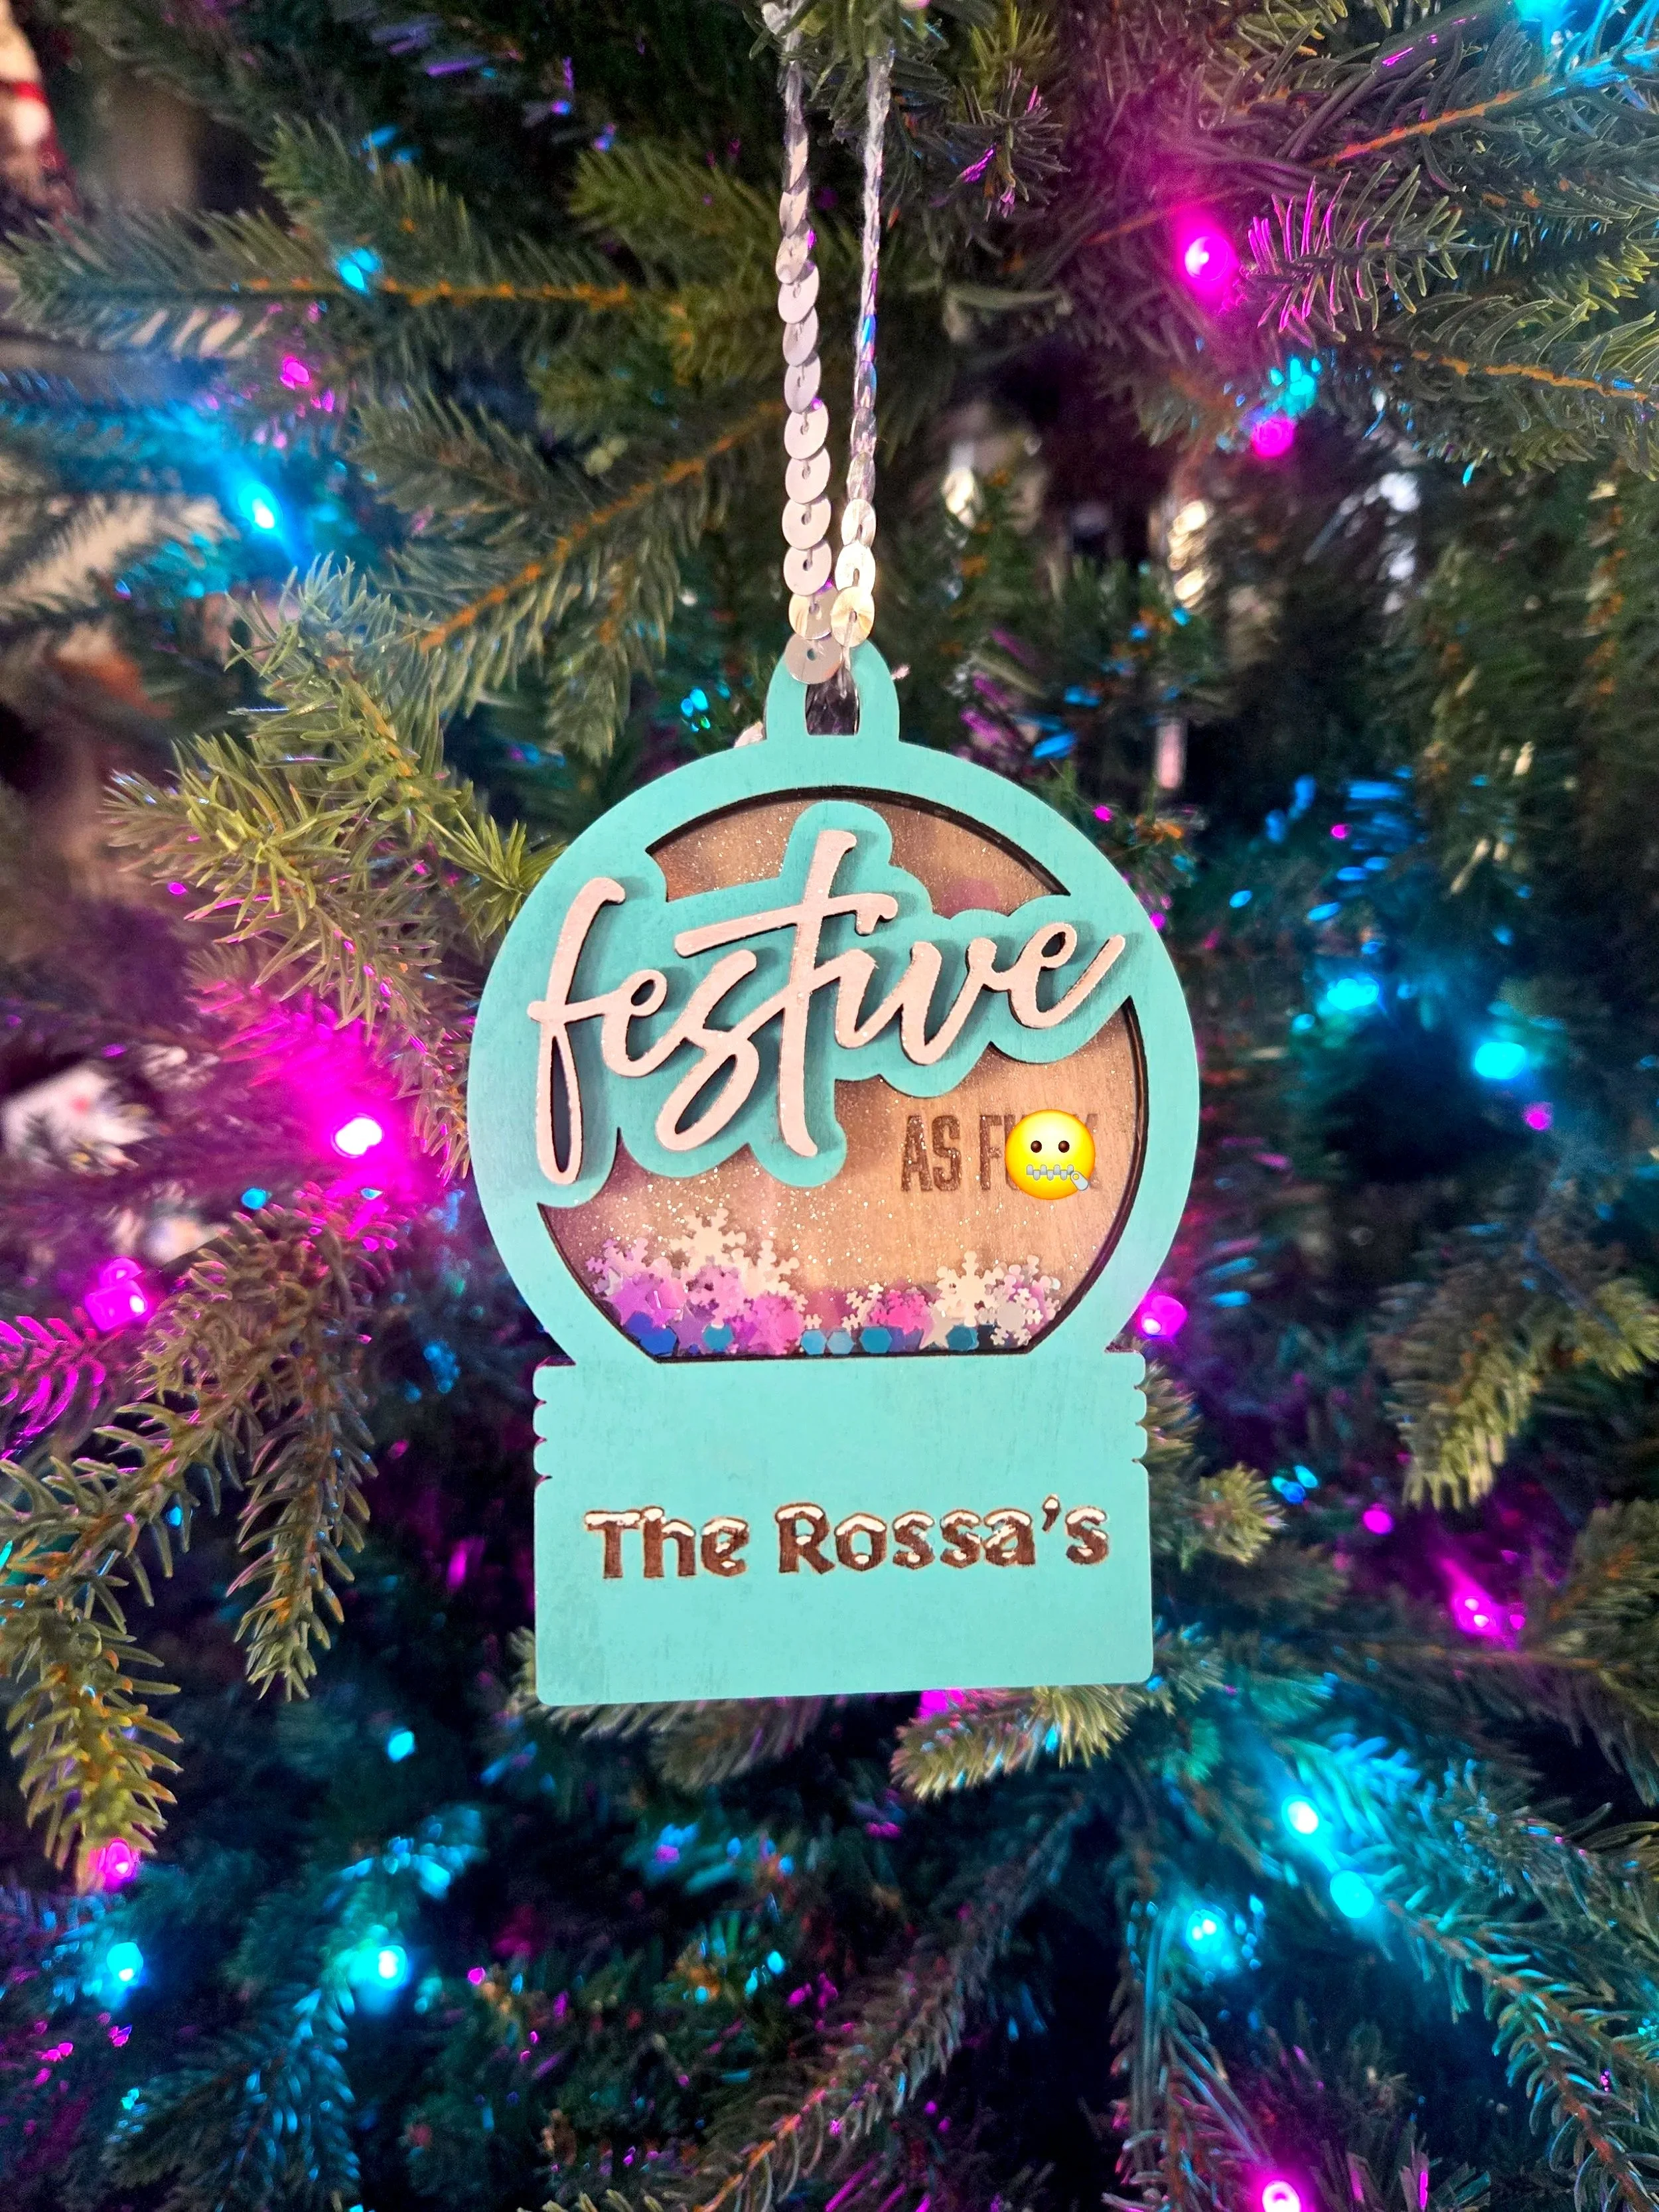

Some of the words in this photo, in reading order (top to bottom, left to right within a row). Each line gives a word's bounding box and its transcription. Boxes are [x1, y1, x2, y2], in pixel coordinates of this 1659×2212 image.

[528, 830, 1125, 1185] festive
[901, 1114, 962, 1192] AS
[583, 1505, 749, 1578] The
[774, 1494, 1111, 1575] Rossa's
